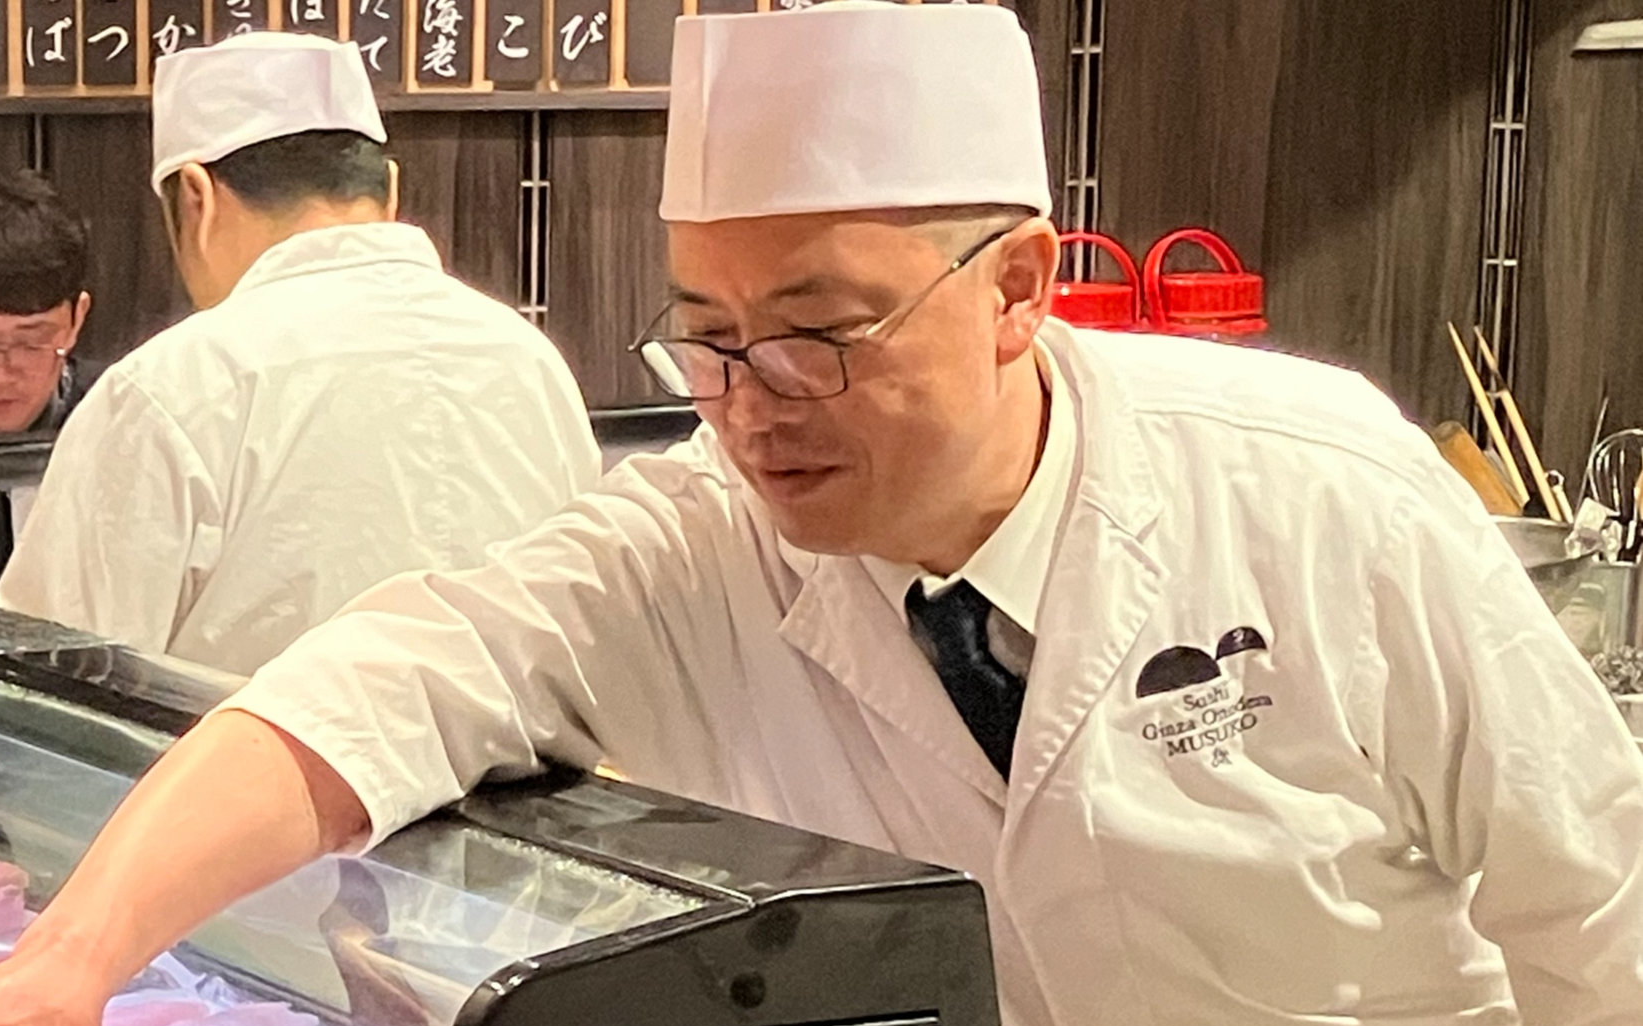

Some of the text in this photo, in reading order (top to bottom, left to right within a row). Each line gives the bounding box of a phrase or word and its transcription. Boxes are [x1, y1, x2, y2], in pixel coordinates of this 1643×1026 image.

[421, 0, 464, 77] 海老
[1142, 719, 1197, 741] Ginza
[1167, 712, 1258, 757] MUSUKO
